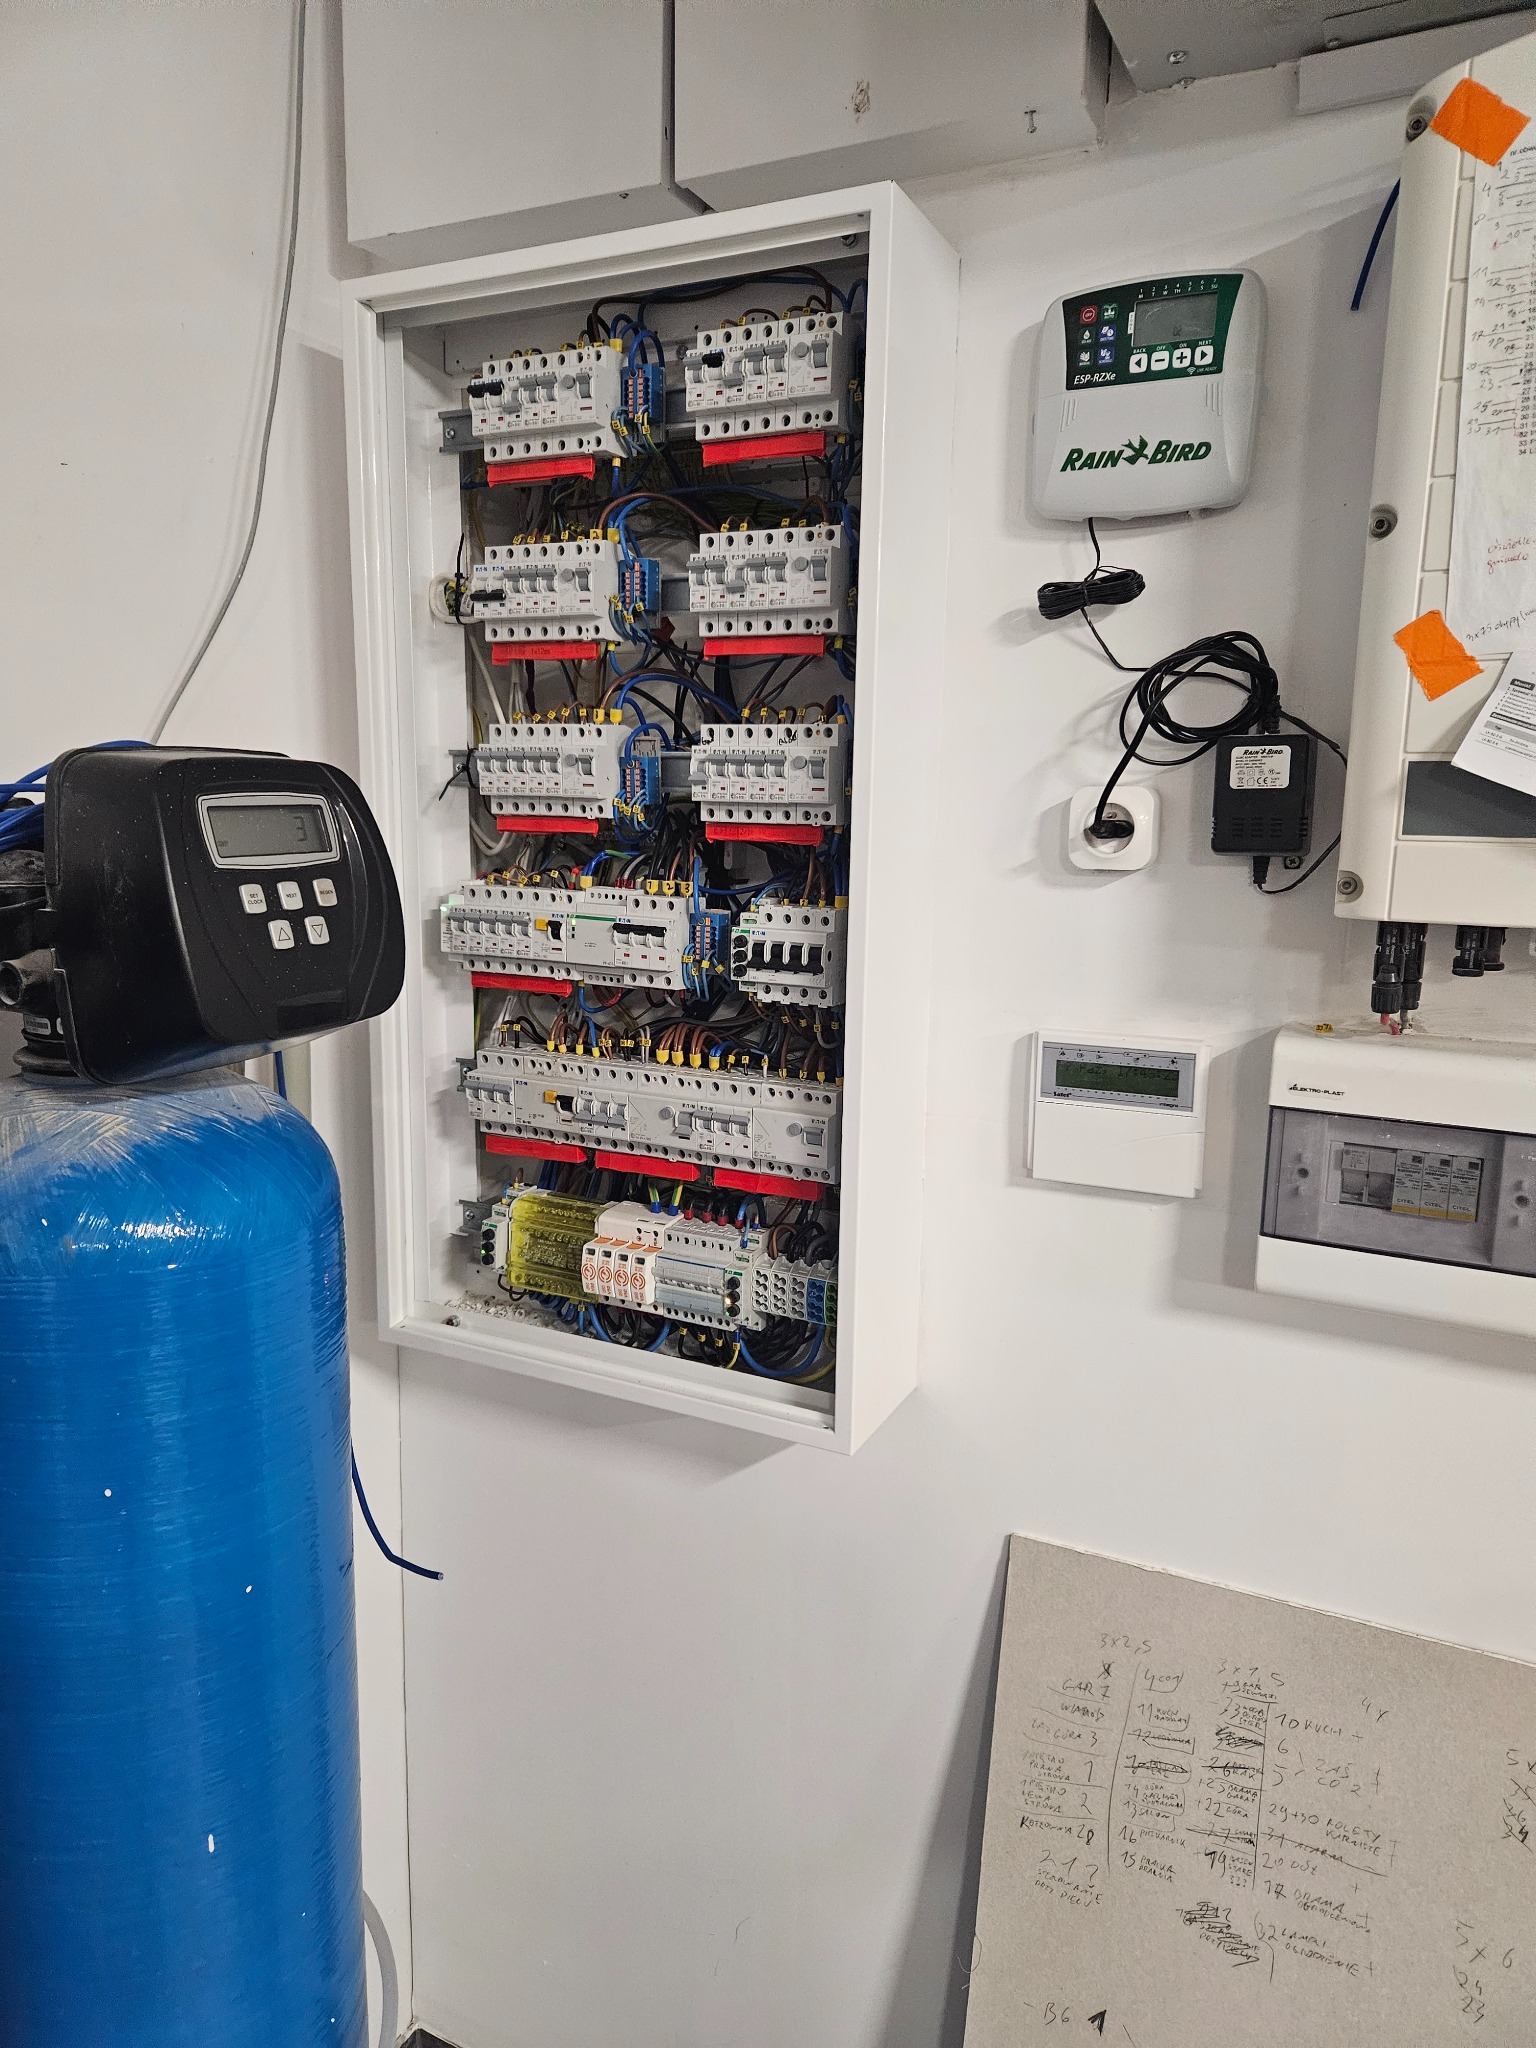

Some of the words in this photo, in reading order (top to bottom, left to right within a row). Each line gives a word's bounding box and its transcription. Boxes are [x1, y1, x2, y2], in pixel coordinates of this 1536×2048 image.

[1483, 182, 1491, 197] 4
[1507, 230, 1520, 238] 10
[1473, 267, 1488, 277] 11
[1487, 278, 1504, 286] 12
[1074, 372, 1116, 385] ESP-RZXe
[1060, 448, 1125, 472] RAIN
[1148, 439, 1212, 465] BIRD
[1062, 1679, 1093, 1696] GAR
[1275, 1714, 1299, 1729] 10
[1278, 1738, 1288, 1753] 6
[1119, 1825, 1137, 1844] 16
